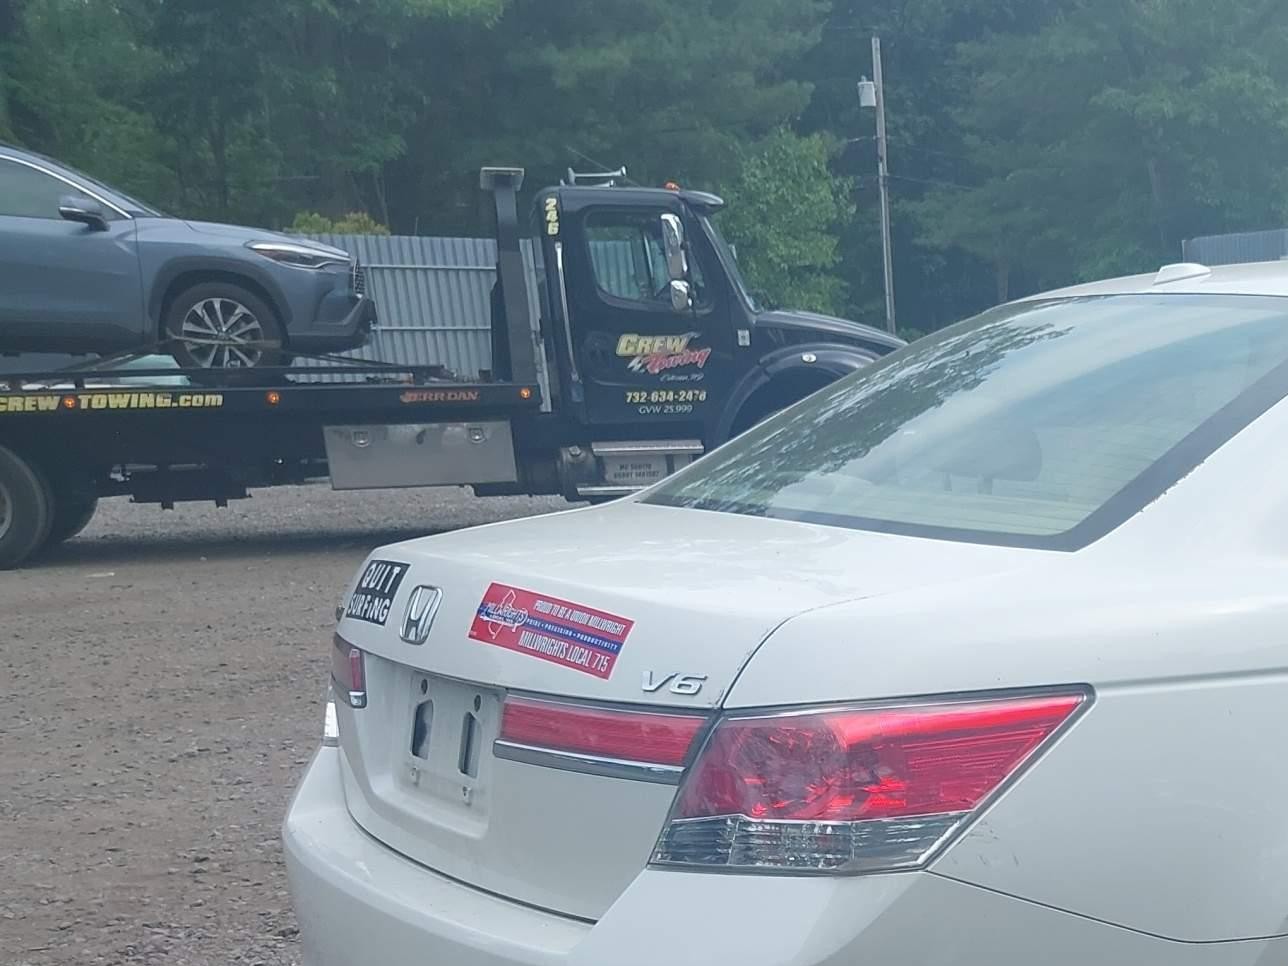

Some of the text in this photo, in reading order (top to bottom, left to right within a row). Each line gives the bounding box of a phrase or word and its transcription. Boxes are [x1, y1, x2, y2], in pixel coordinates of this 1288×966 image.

[78, 393, 223, 409] TOWING.com
[361, 563, 402, 593] QUIT
[518, 630, 611, 673] MILLWRIGHTS LOCAL 715
[641, 671, 708, 695] V6
